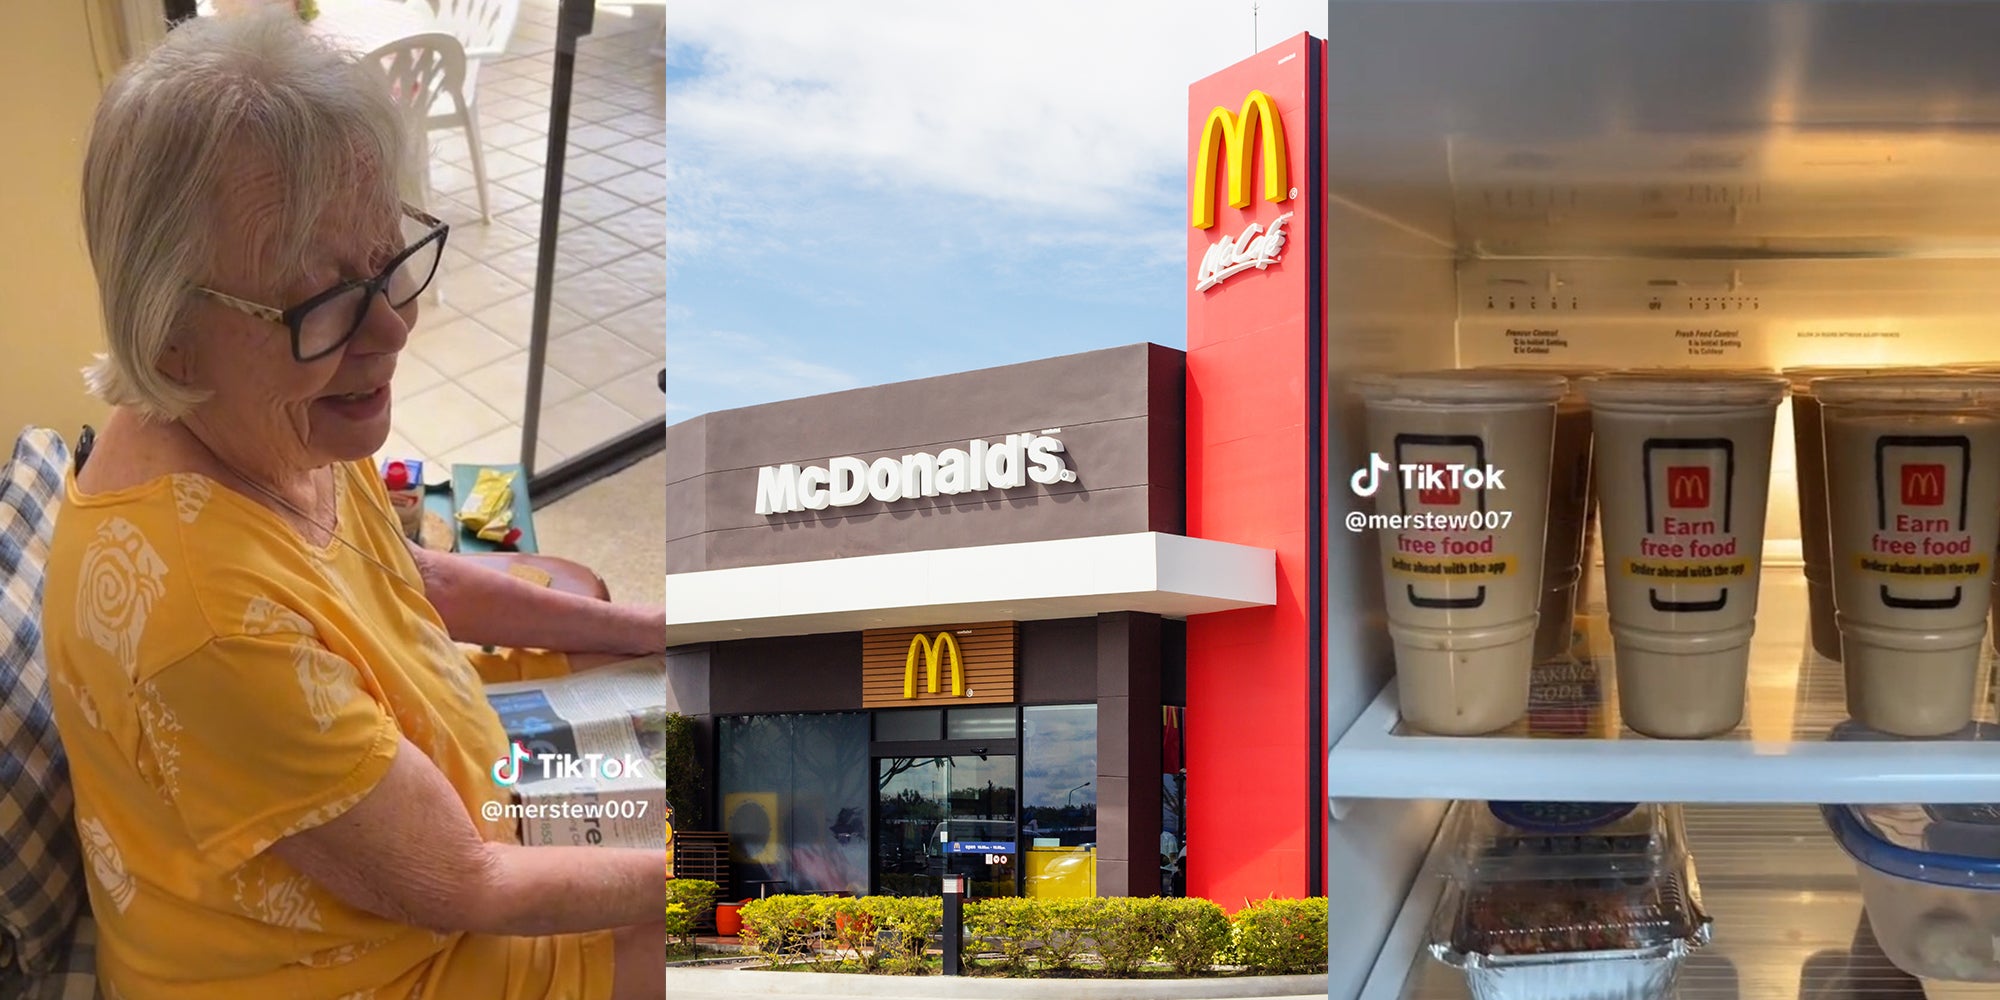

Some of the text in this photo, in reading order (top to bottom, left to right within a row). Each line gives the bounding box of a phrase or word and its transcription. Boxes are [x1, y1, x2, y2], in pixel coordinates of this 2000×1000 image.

[755, 432, 1065, 515] McDonald's
[1664, 517, 1714, 535] Earn
[1897, 515, 1948, 532] Earn
[1398, 534, 1493, 555] free food
[1641, 537, 1736, 557] free food
[1872, 534, 1971, 555] free food
[1413, 560, 1441, 574] ahead
[1444, 561, 1466, 574] with
[1469, 561, 1486, 574] the
[1488, 561, 1506, 574] app
[1657, 565, 1688, 577] ahead
[1690, 565, 1713, 577] with
[1714, 564, 1729, 576] the
[1730, 564, 1745, 575] app
[1889, 562, 1921, 574] ahead
[1924, 563, 1946, 575] with
[1948, 563, 1963, 574] the
